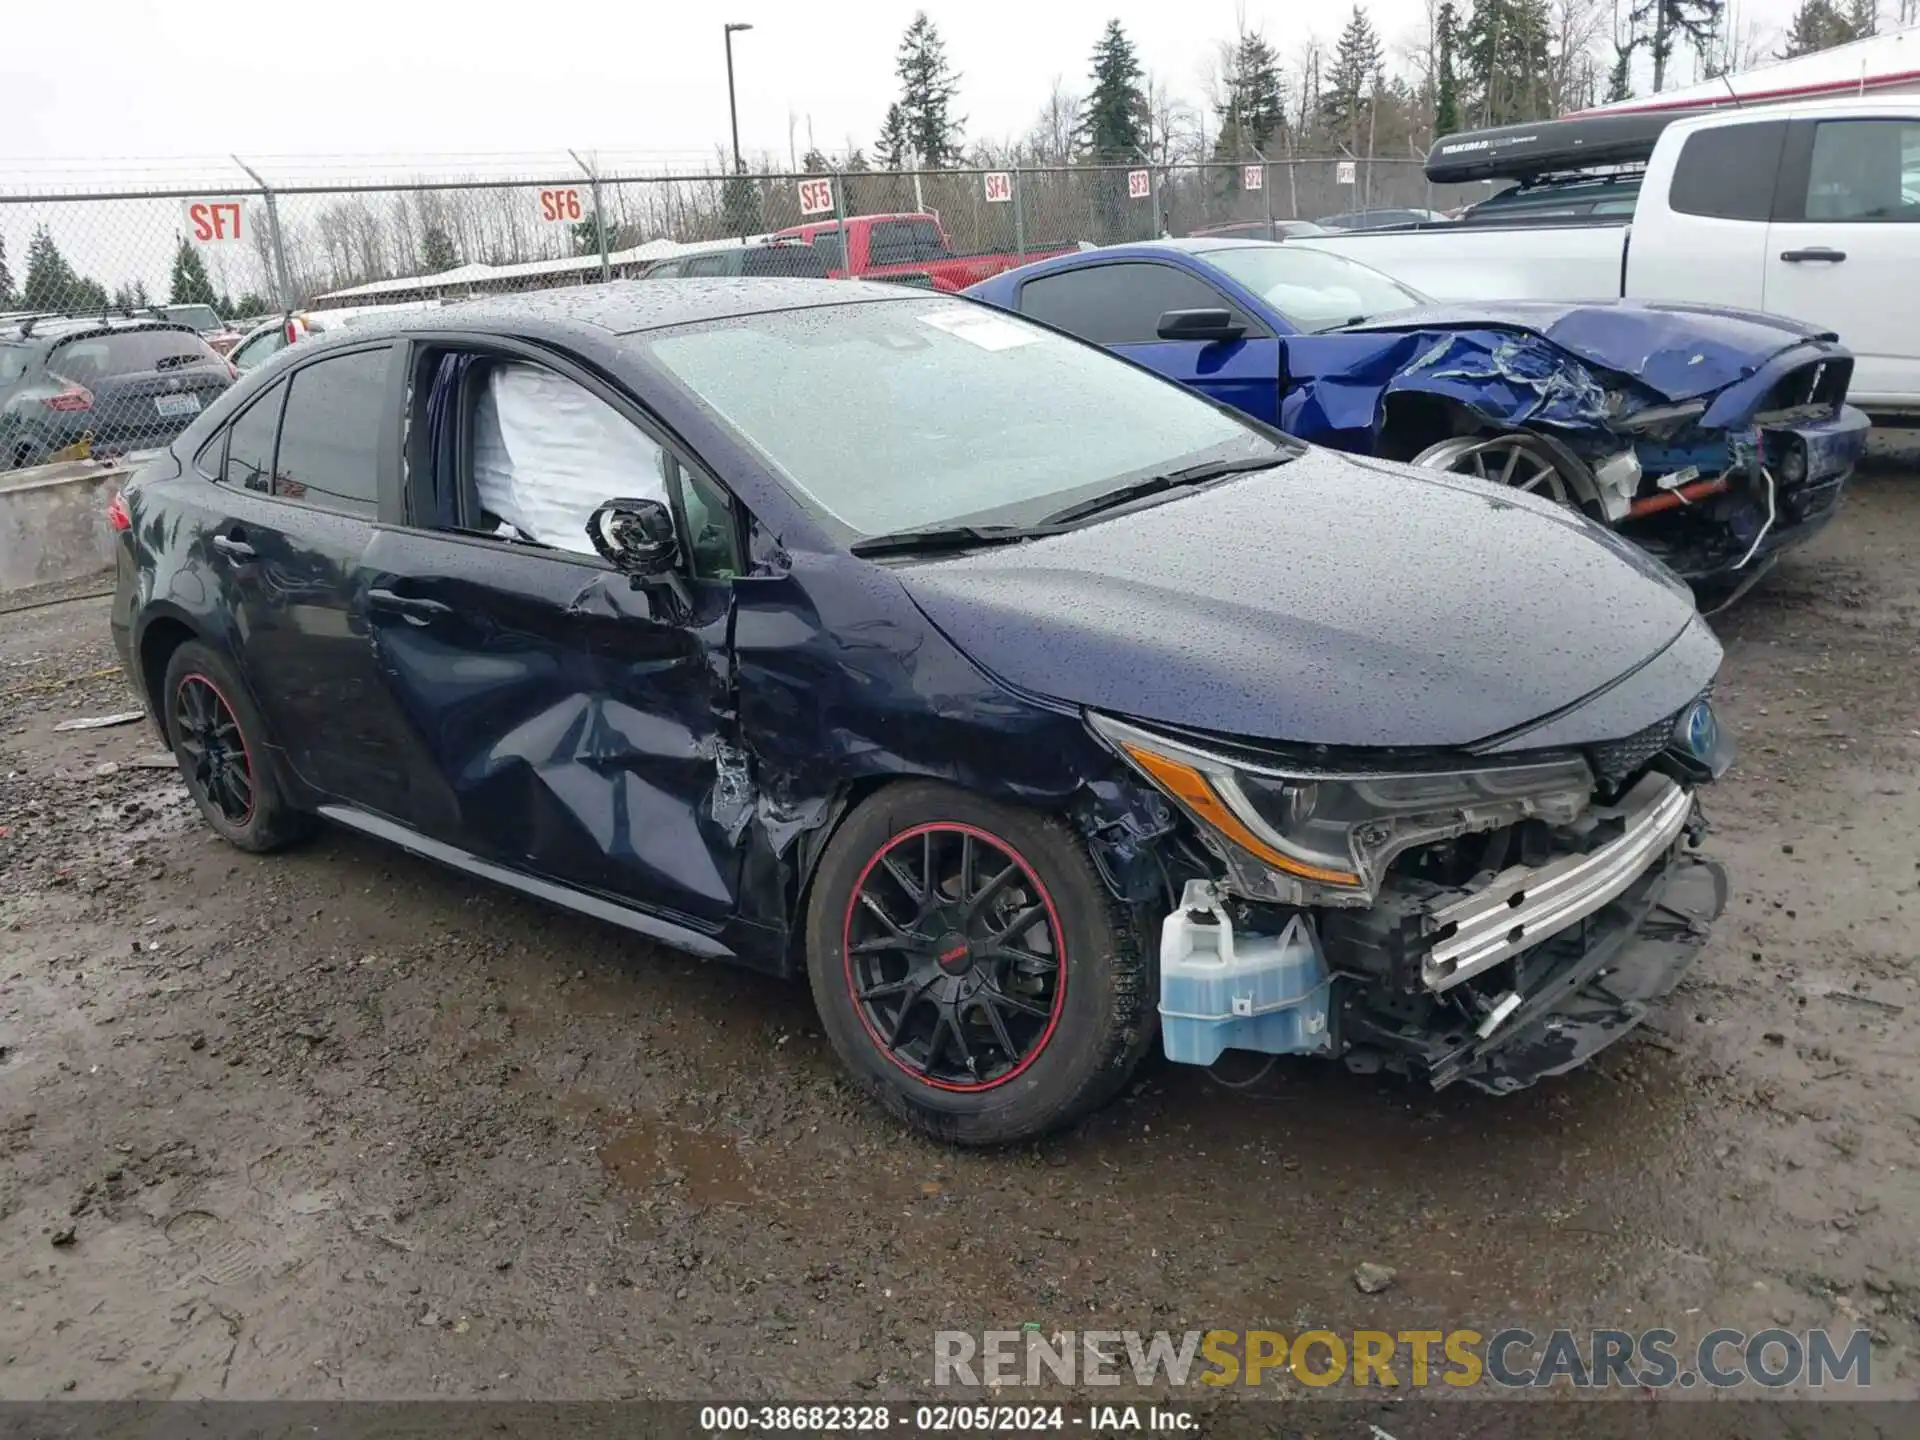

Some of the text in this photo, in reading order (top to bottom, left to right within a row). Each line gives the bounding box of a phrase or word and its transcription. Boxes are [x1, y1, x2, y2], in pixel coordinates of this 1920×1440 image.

[801, 182, 830, 210] SF5
[987, 175, 1008, 198] SF4
[1130, 174, 1148, 194] SF3
[541, 190, 581, 221] SF6
[190, 203, 240, 240] SF7
